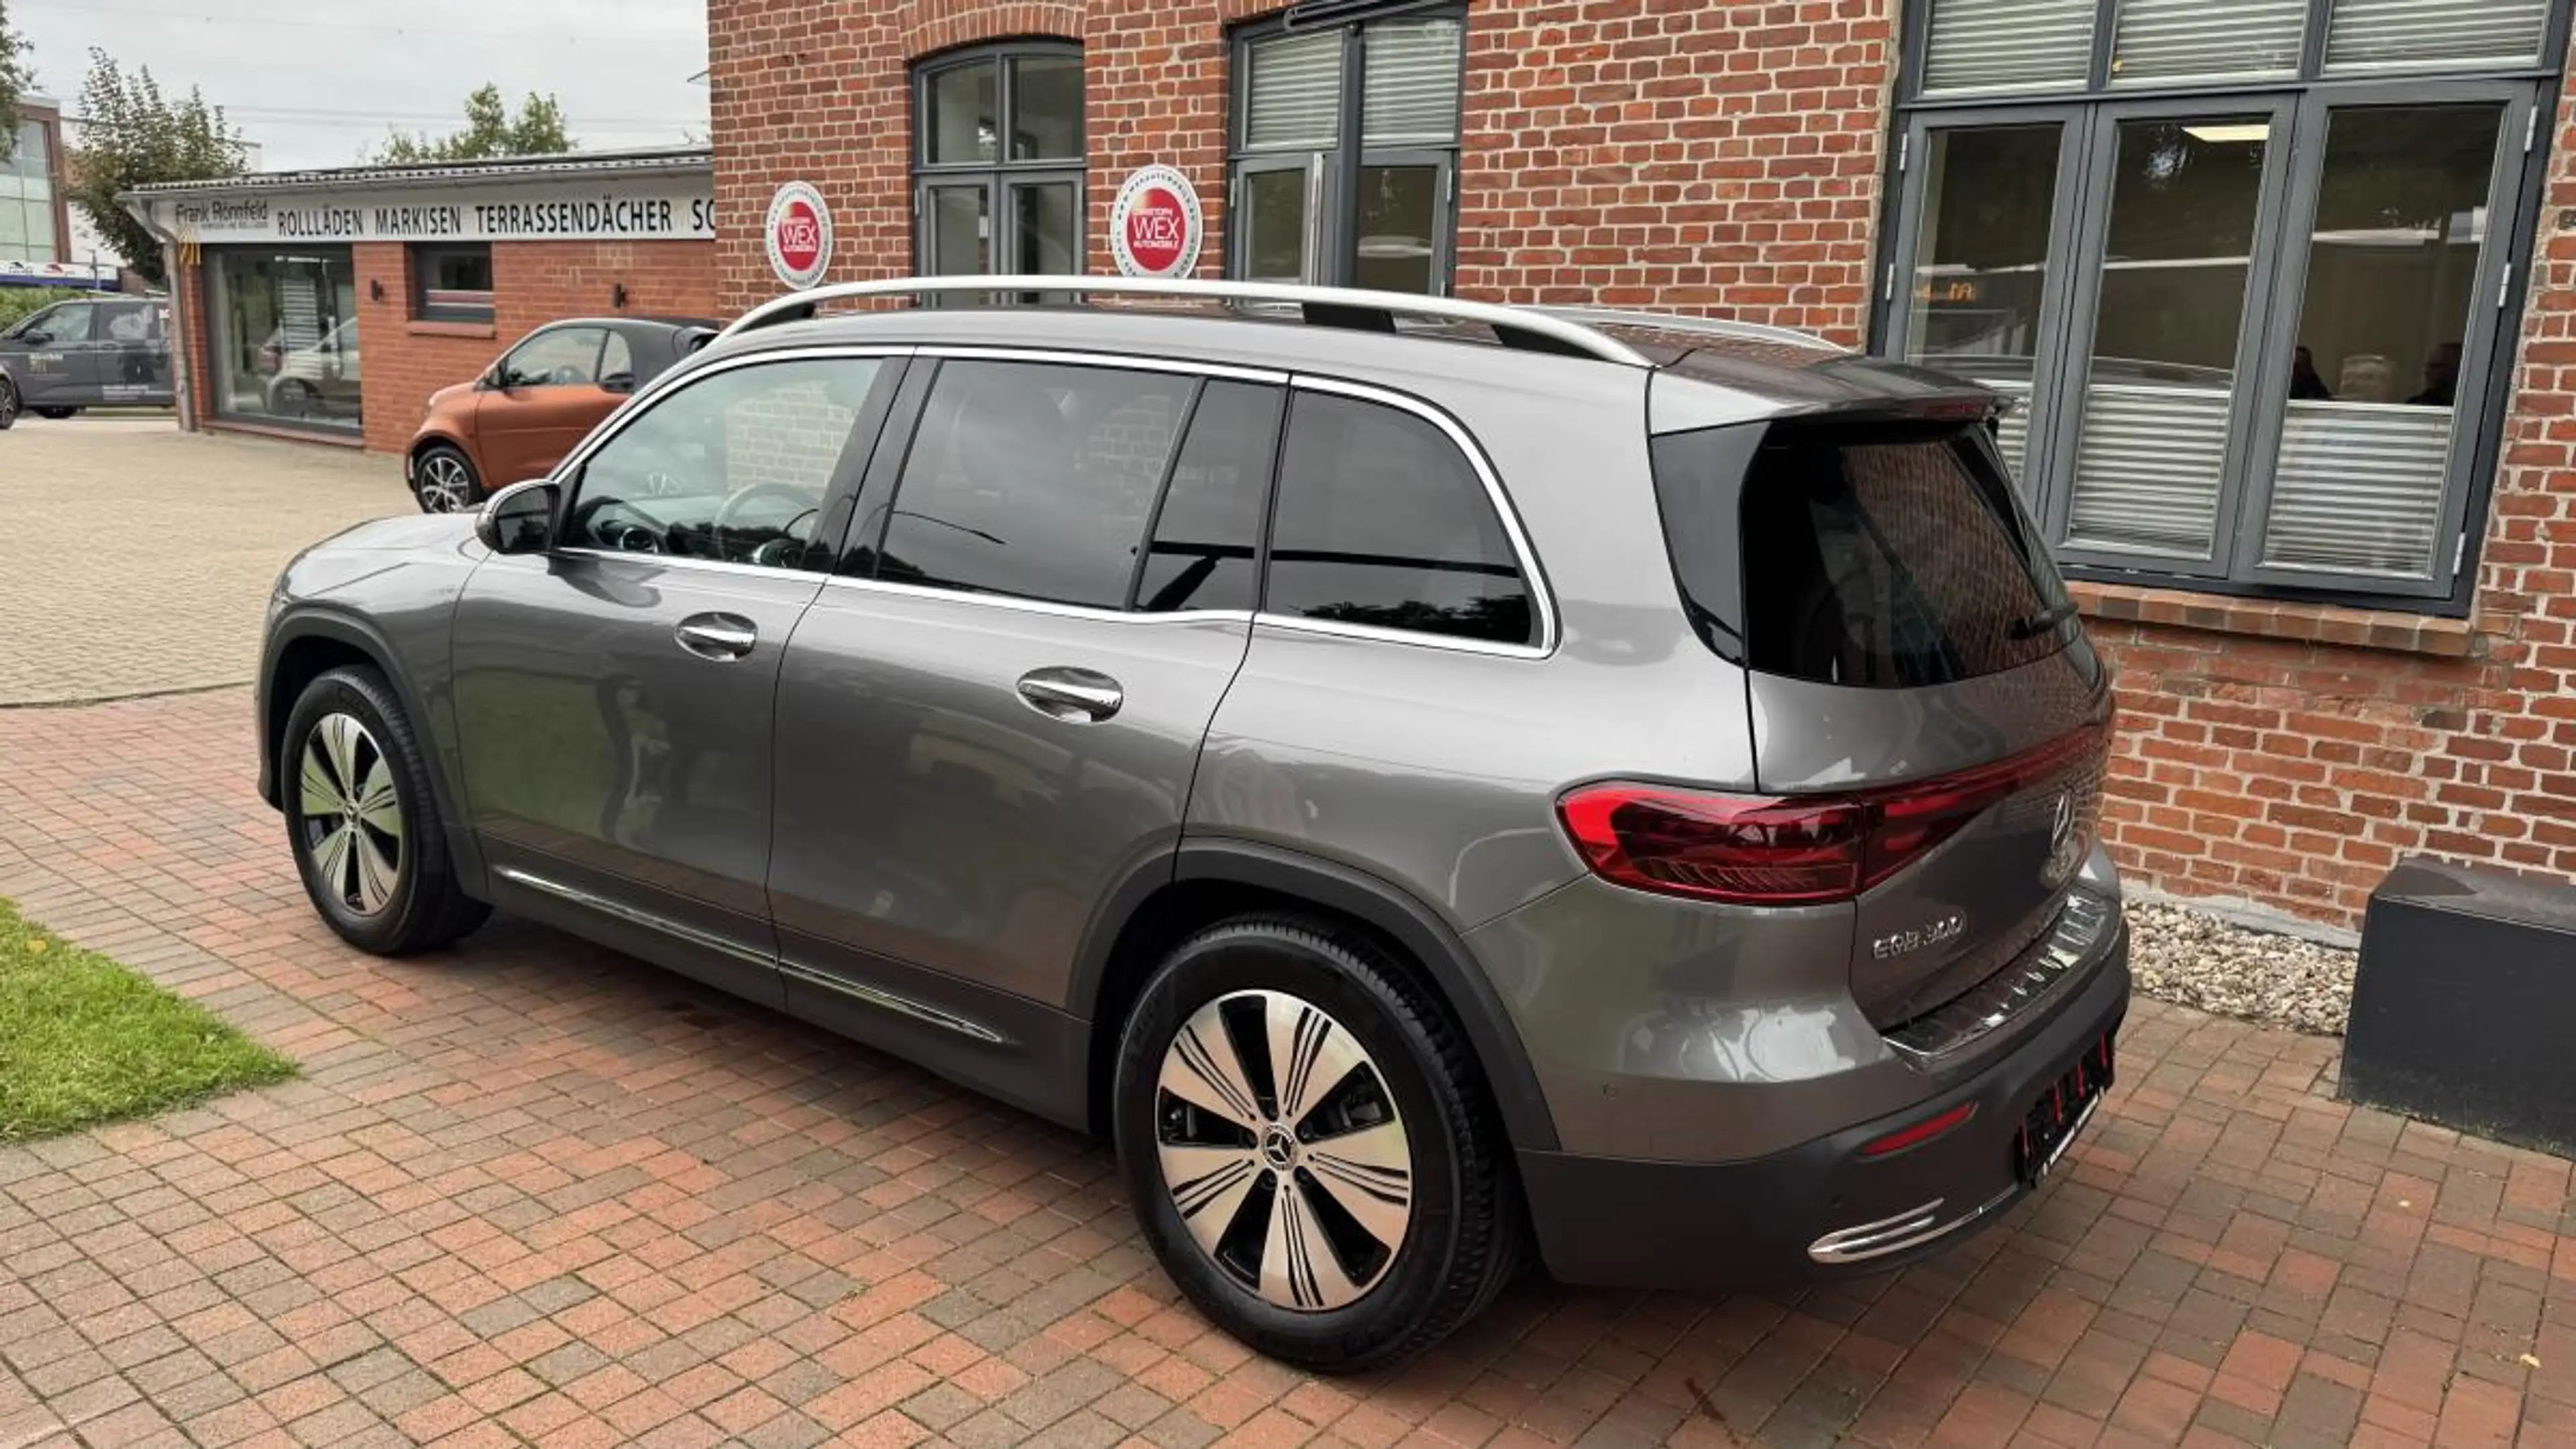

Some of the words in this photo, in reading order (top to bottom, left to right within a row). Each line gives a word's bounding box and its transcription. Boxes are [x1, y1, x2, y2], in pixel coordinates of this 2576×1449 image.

[176, 203, 209, 223] Frank
[277, 203, 364, 236] ROLLLÄDEN
[375, 206, 462, 235] MARKISEN
[475, 194, 673, 233] TERRASSENDÄCHER
[782, 225, 817, 244] WEX
[1133, 216, 1181, 240] WEX
